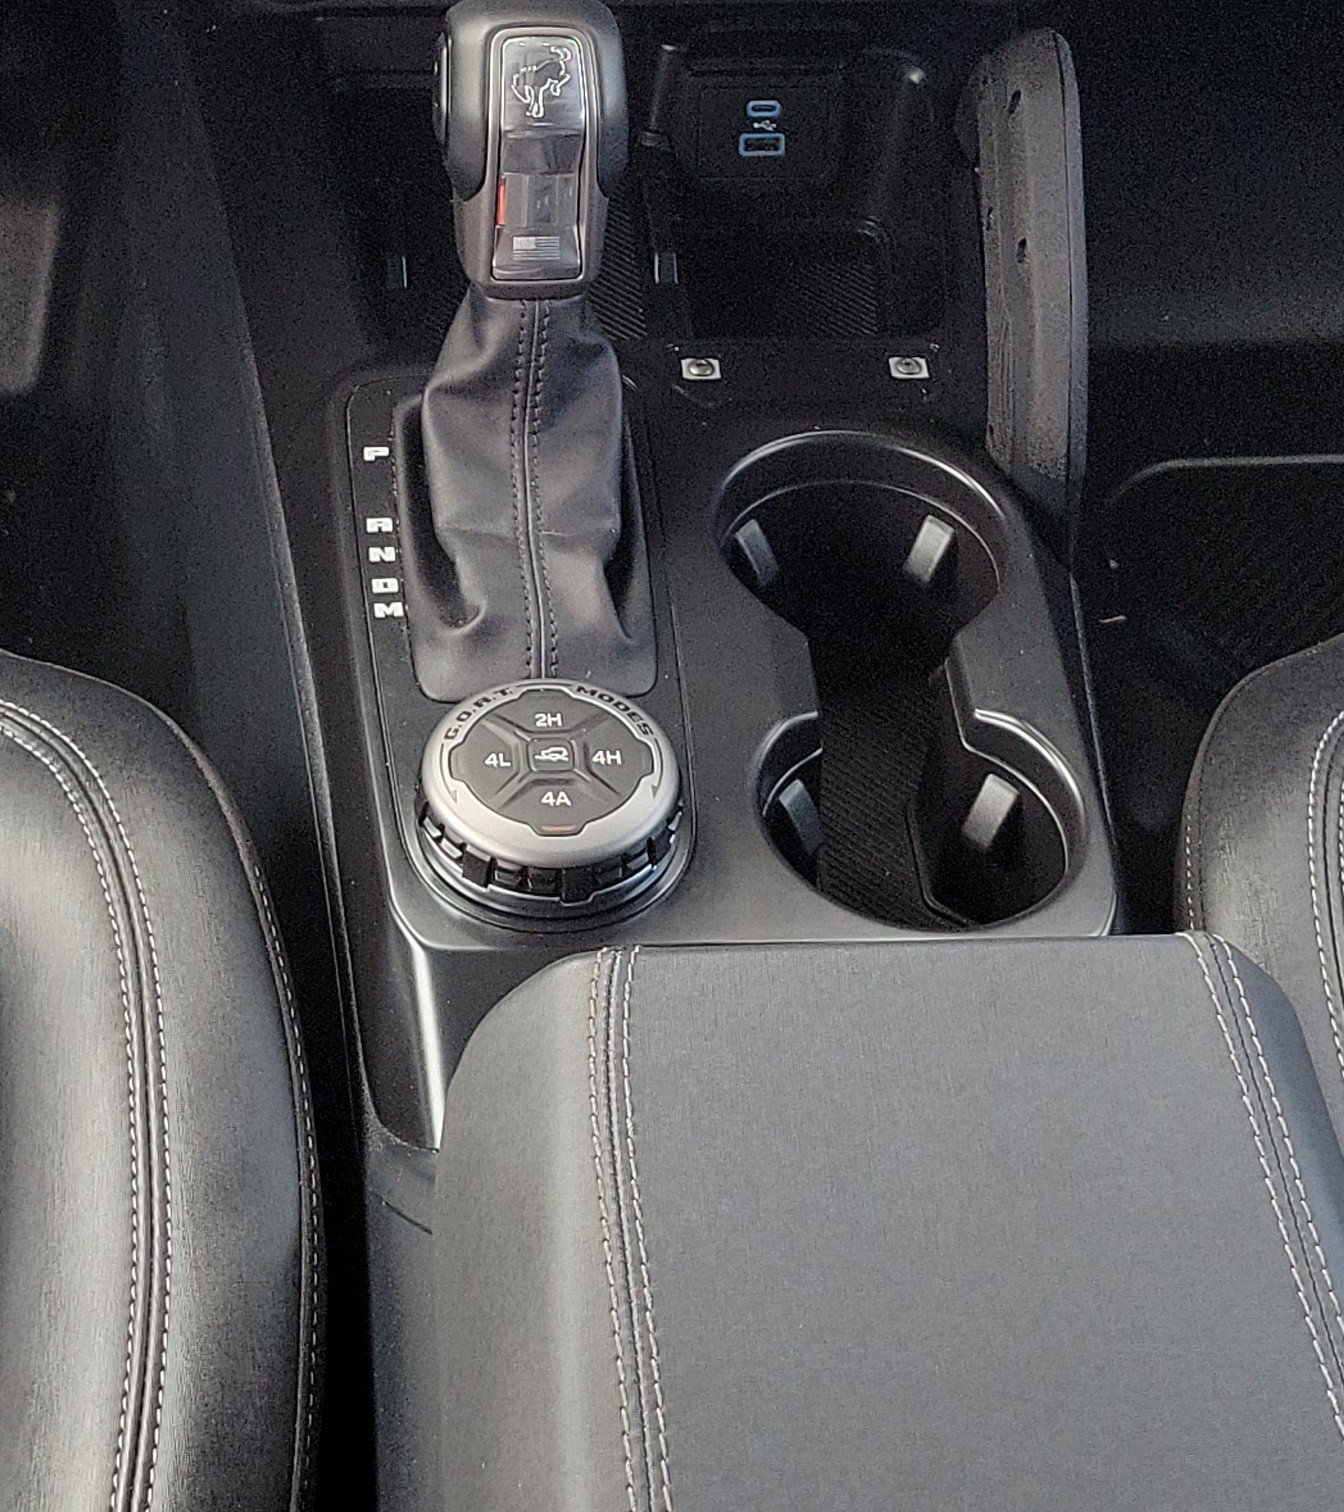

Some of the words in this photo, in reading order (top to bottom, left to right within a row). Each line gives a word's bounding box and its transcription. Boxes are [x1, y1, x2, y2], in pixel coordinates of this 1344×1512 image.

[363, 446, 390, 462] P
[369, 547, 396, 562] N
[374, 602, 404, 618] M
[576, 686, 654, 737] MODES
[535, 713, 562, 727] 2H
[485, 752, 511, 767] 4L
[592, 750, 622, 765] 4H
[541, 791, 572, 807] 4A
